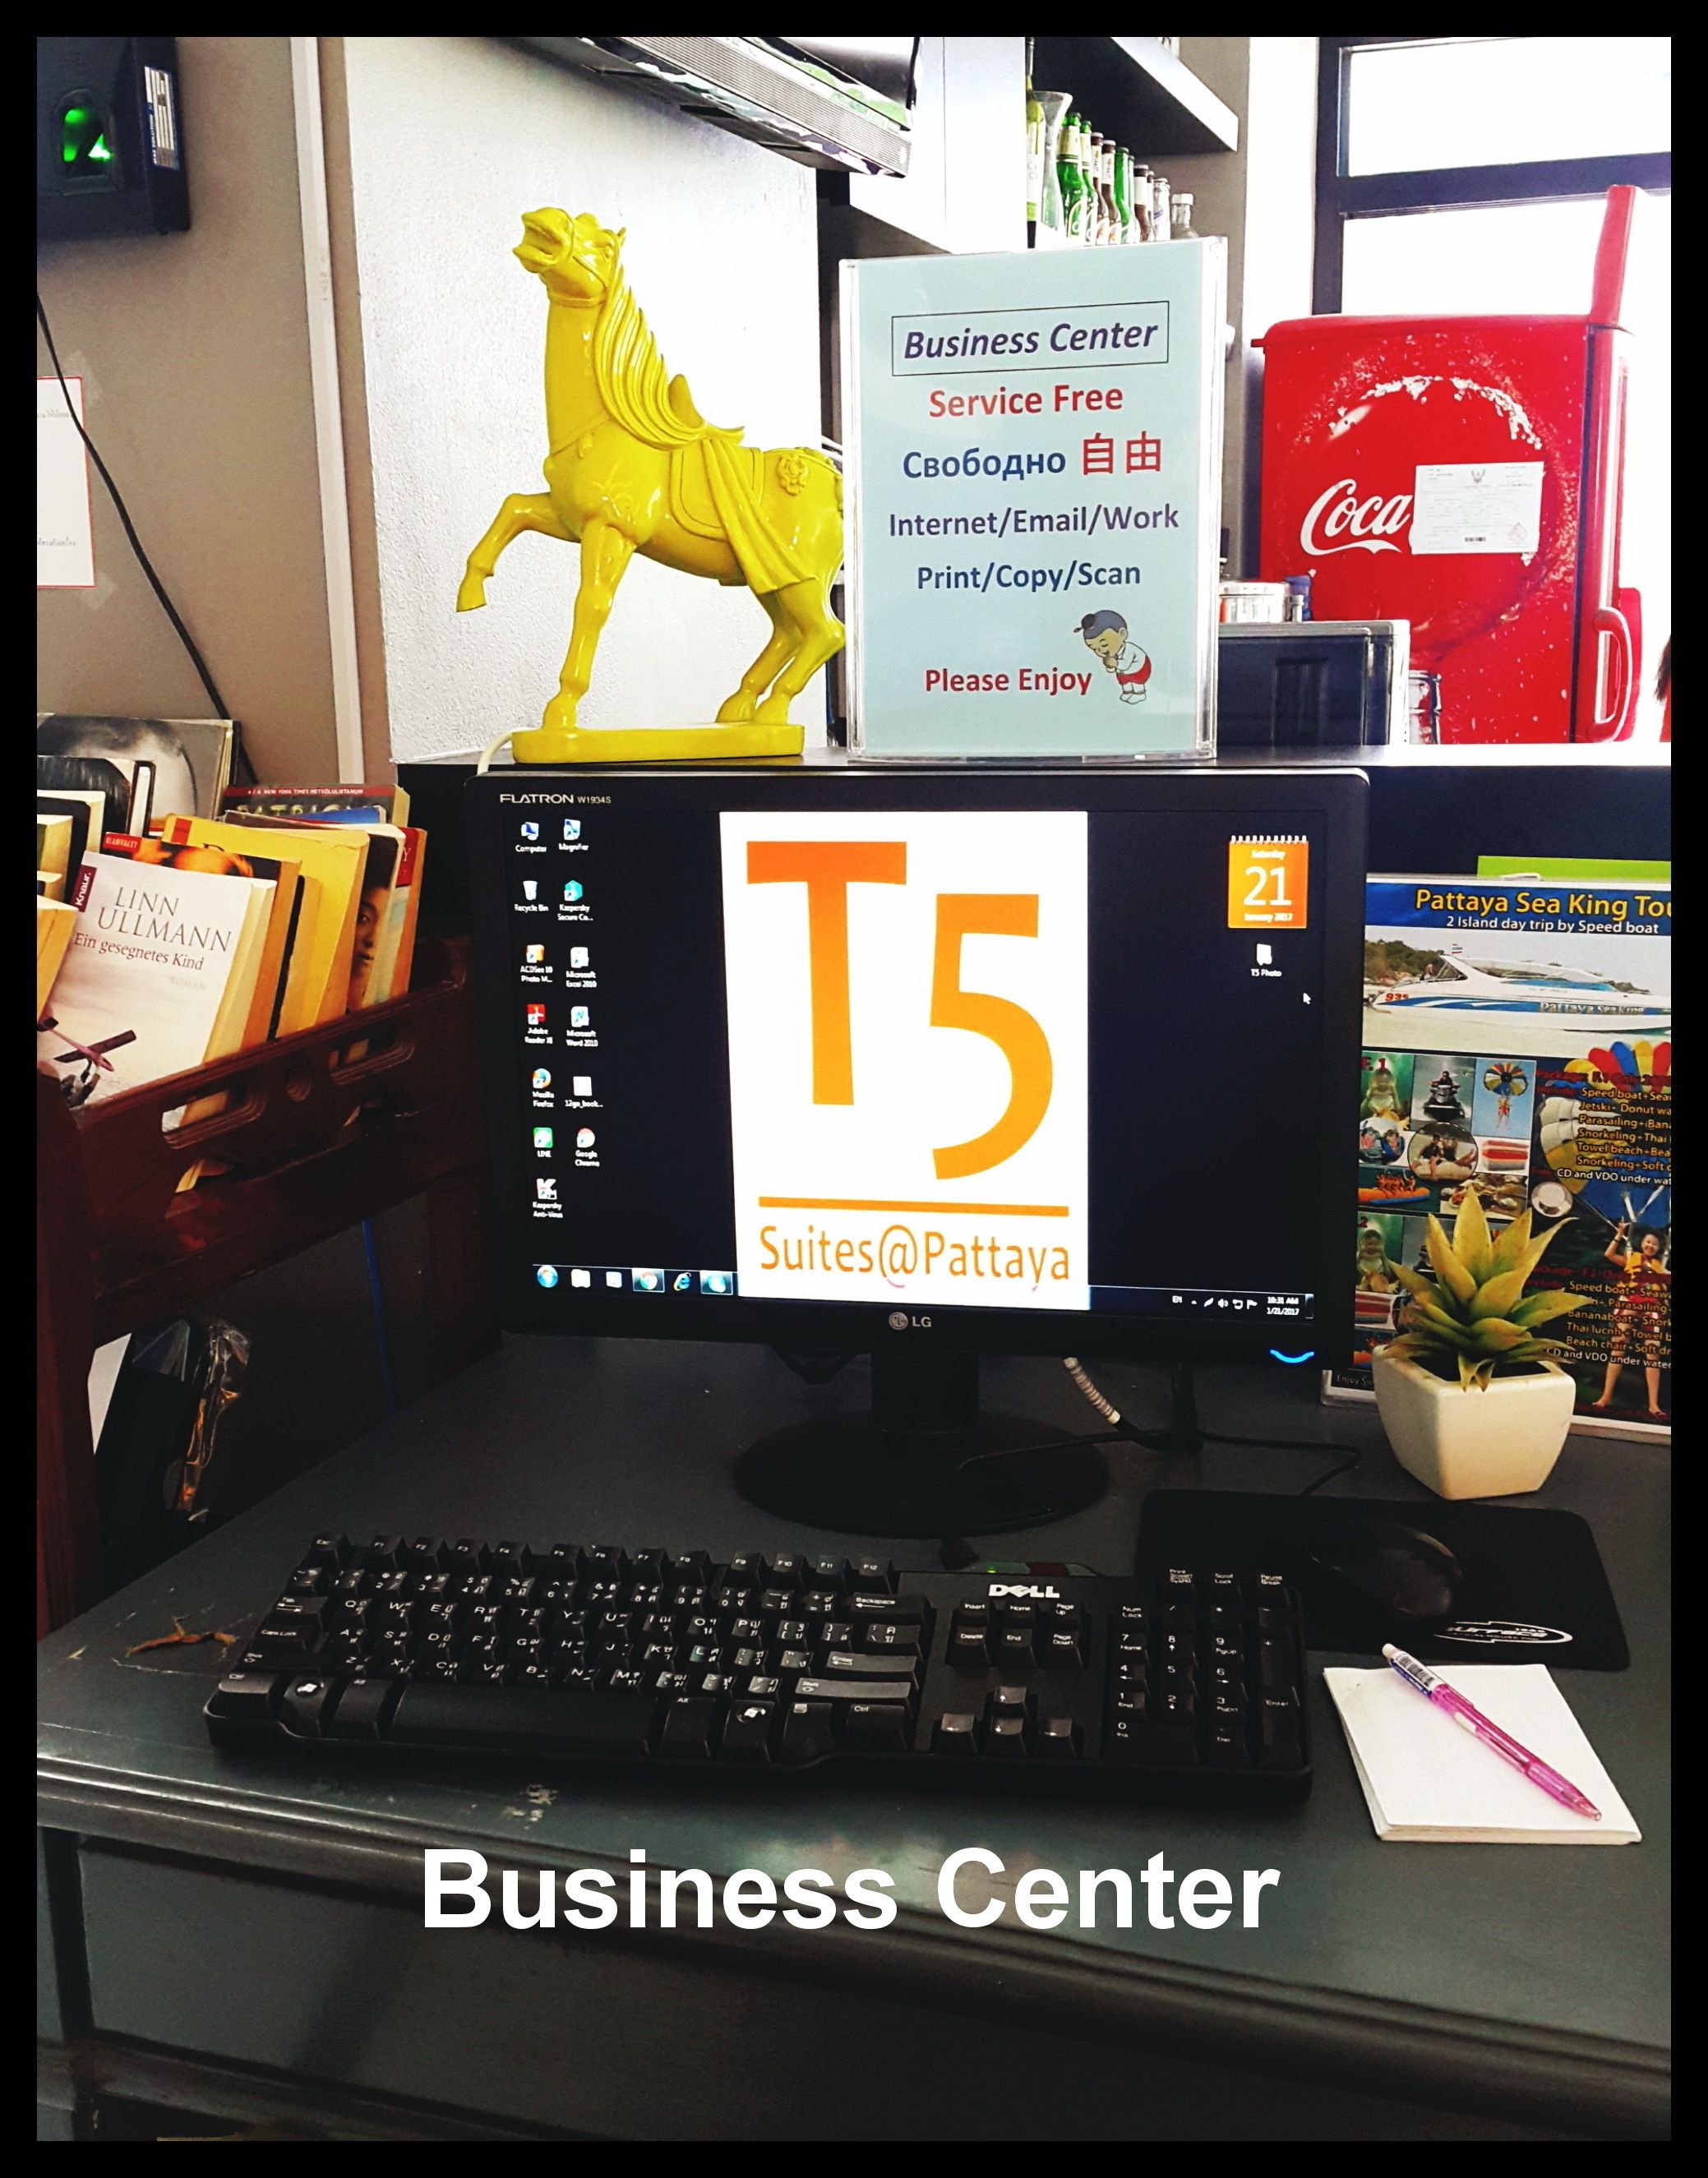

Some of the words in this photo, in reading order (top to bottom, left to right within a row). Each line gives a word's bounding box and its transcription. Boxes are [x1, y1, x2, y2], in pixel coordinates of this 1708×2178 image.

[904, 328, 1039, 359] Business
[1050, 323, 1158, 352] Center
[930, 386, 1042, 418] Service
[1054, 385, 1123, 412] Free
[903, 447, 1066, 481] Свободно
[1083, 431, 1161, 474] 自由
[890, 503, 1179, 538] Internet/Email/Work
[918, 561, 1140, 592] Print/Copy/Scan
[926, 667, 1009, 693] Please
[1019, 668, 1092, 695] Enjoy
[500, 794, 574, 804] FLATRON
[577, 796, 612, 805] W1934S
[1244, 866, 1291, 906] 21
[116, 887, 178, 916] LINN
[1416, 889, 1508, 916] Pattaya
[1516, 892, 1560, 914] Sea
[1568, 894, 1627, 921] King
[98, 907, 231, 952] ULLMANN
[1447, 916, 1454, 927] 2
[1457, 916, 1498, 929] Island
[1501, 917, 1525, 932] day
[1530, 918, 1554, 932] trip
[1558, 919, 1576, 934] by
[1578, 920, 1622, 934] Speed
[1626, 921, 1659, 934] boat
[75, 934, 95, 948] Ein
[99, 940, 168, 963] gesegnetes
[173, 953, 204, 971] Kind
[1581, 1087, 1617, 1099] Speed
[1621, 1104, 1654, 1114] Donut
[1577, 1142, 1608, 1152] Towel
[1557, 1169, 1572, 1177] CD
[1574, 1170, 1593, 1179] and
[1595, 1172, 1618, 1181] VDO
[1621, 1174, 1650, 1184] under
[759, 1225, 1069, 1292] Suites@Pattaya
[1569, 1281, 1602, 1292] Speed
[912, 1316, 931, 1327] LG
[1567, 1322, 1589, 1332] Thai
[1567, 1336, 1597, 1348] Beach
[1563, 1349, 1582, 1359] and
[1585, 1352, 1608, 1361] VDO
[1610, 1355, 1640, 1365] under
[989, 1585, 1059, 1598] DELL
